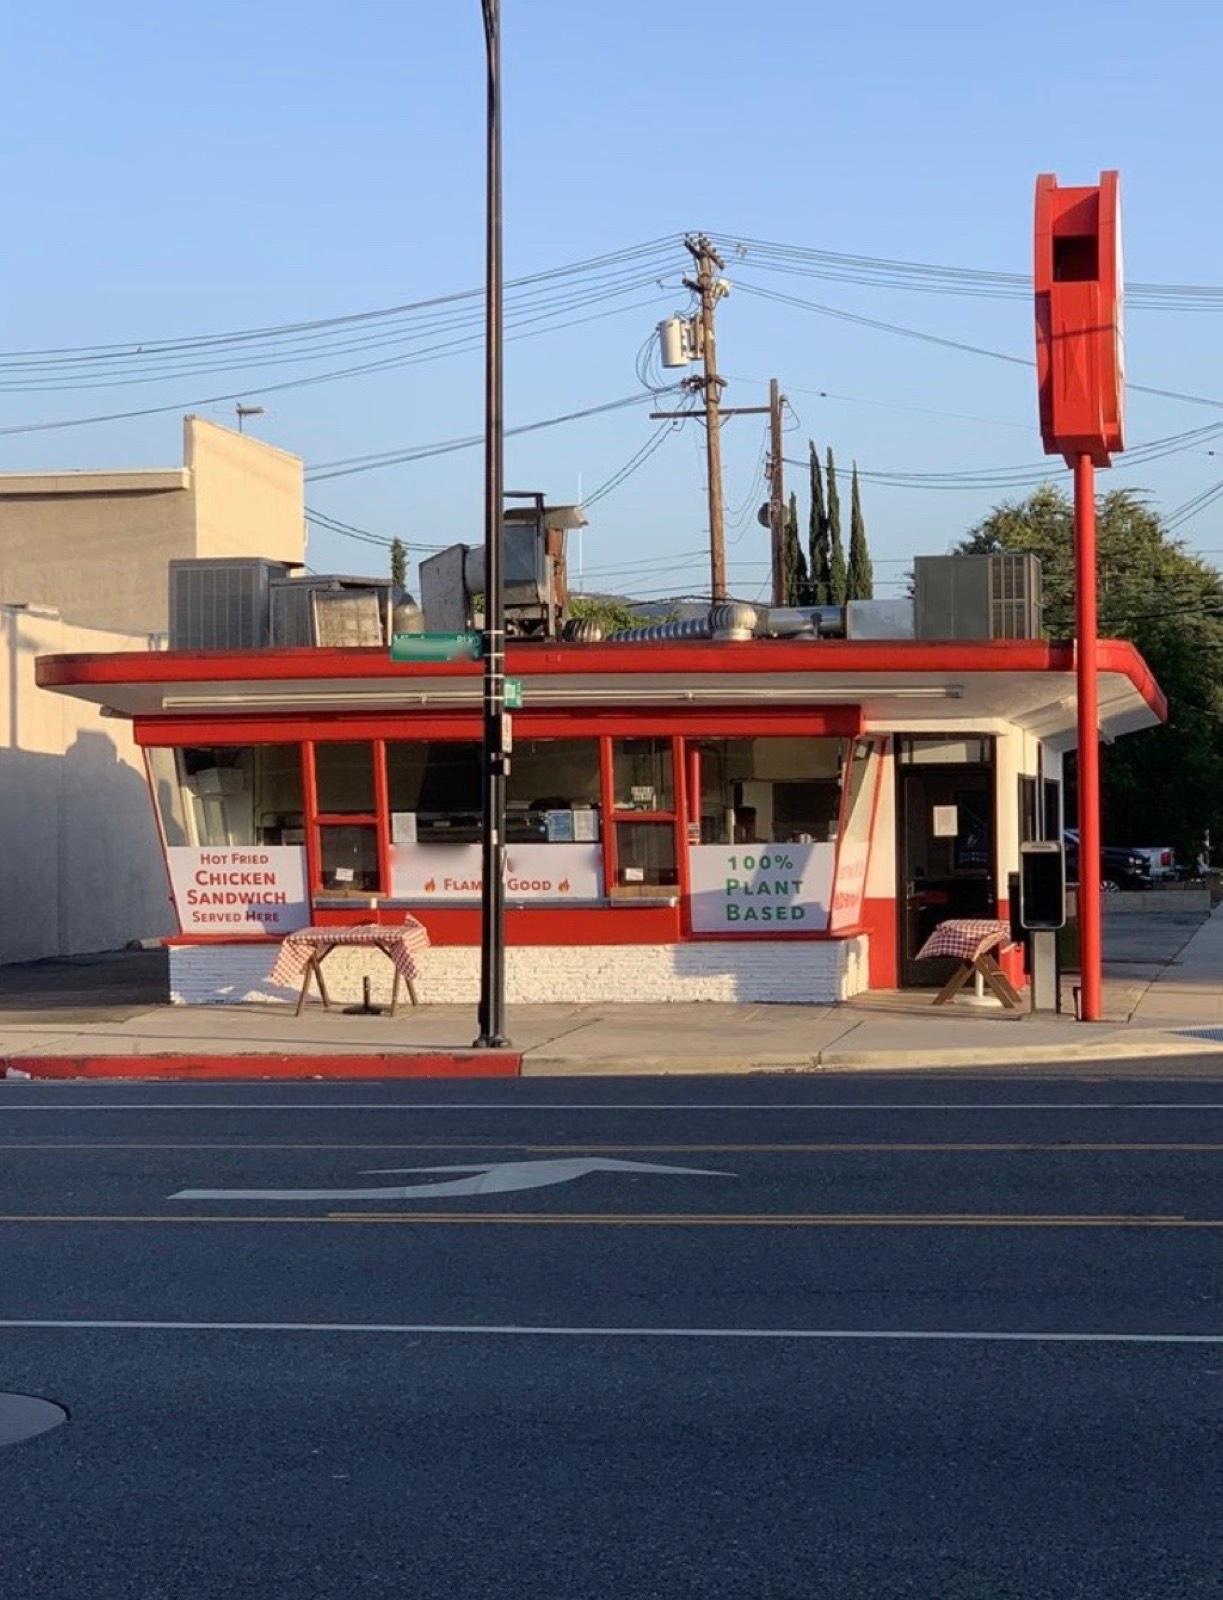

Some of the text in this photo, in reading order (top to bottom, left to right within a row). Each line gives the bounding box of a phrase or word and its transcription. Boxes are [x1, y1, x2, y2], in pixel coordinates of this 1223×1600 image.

[201, 853, 269, 865] HOT FRIED
[728, 855, 793, 870] 100%
[195, 870, 276, 886] CHICKEN
[507, 878, 552, 891] GOOD
[726, 878, 804, 896] PLANT
[187, 889, 287, 905] SANDWICH
[192, 910, 280, 923] SERVED HERE
[726, 904, 806, 921] BASED
